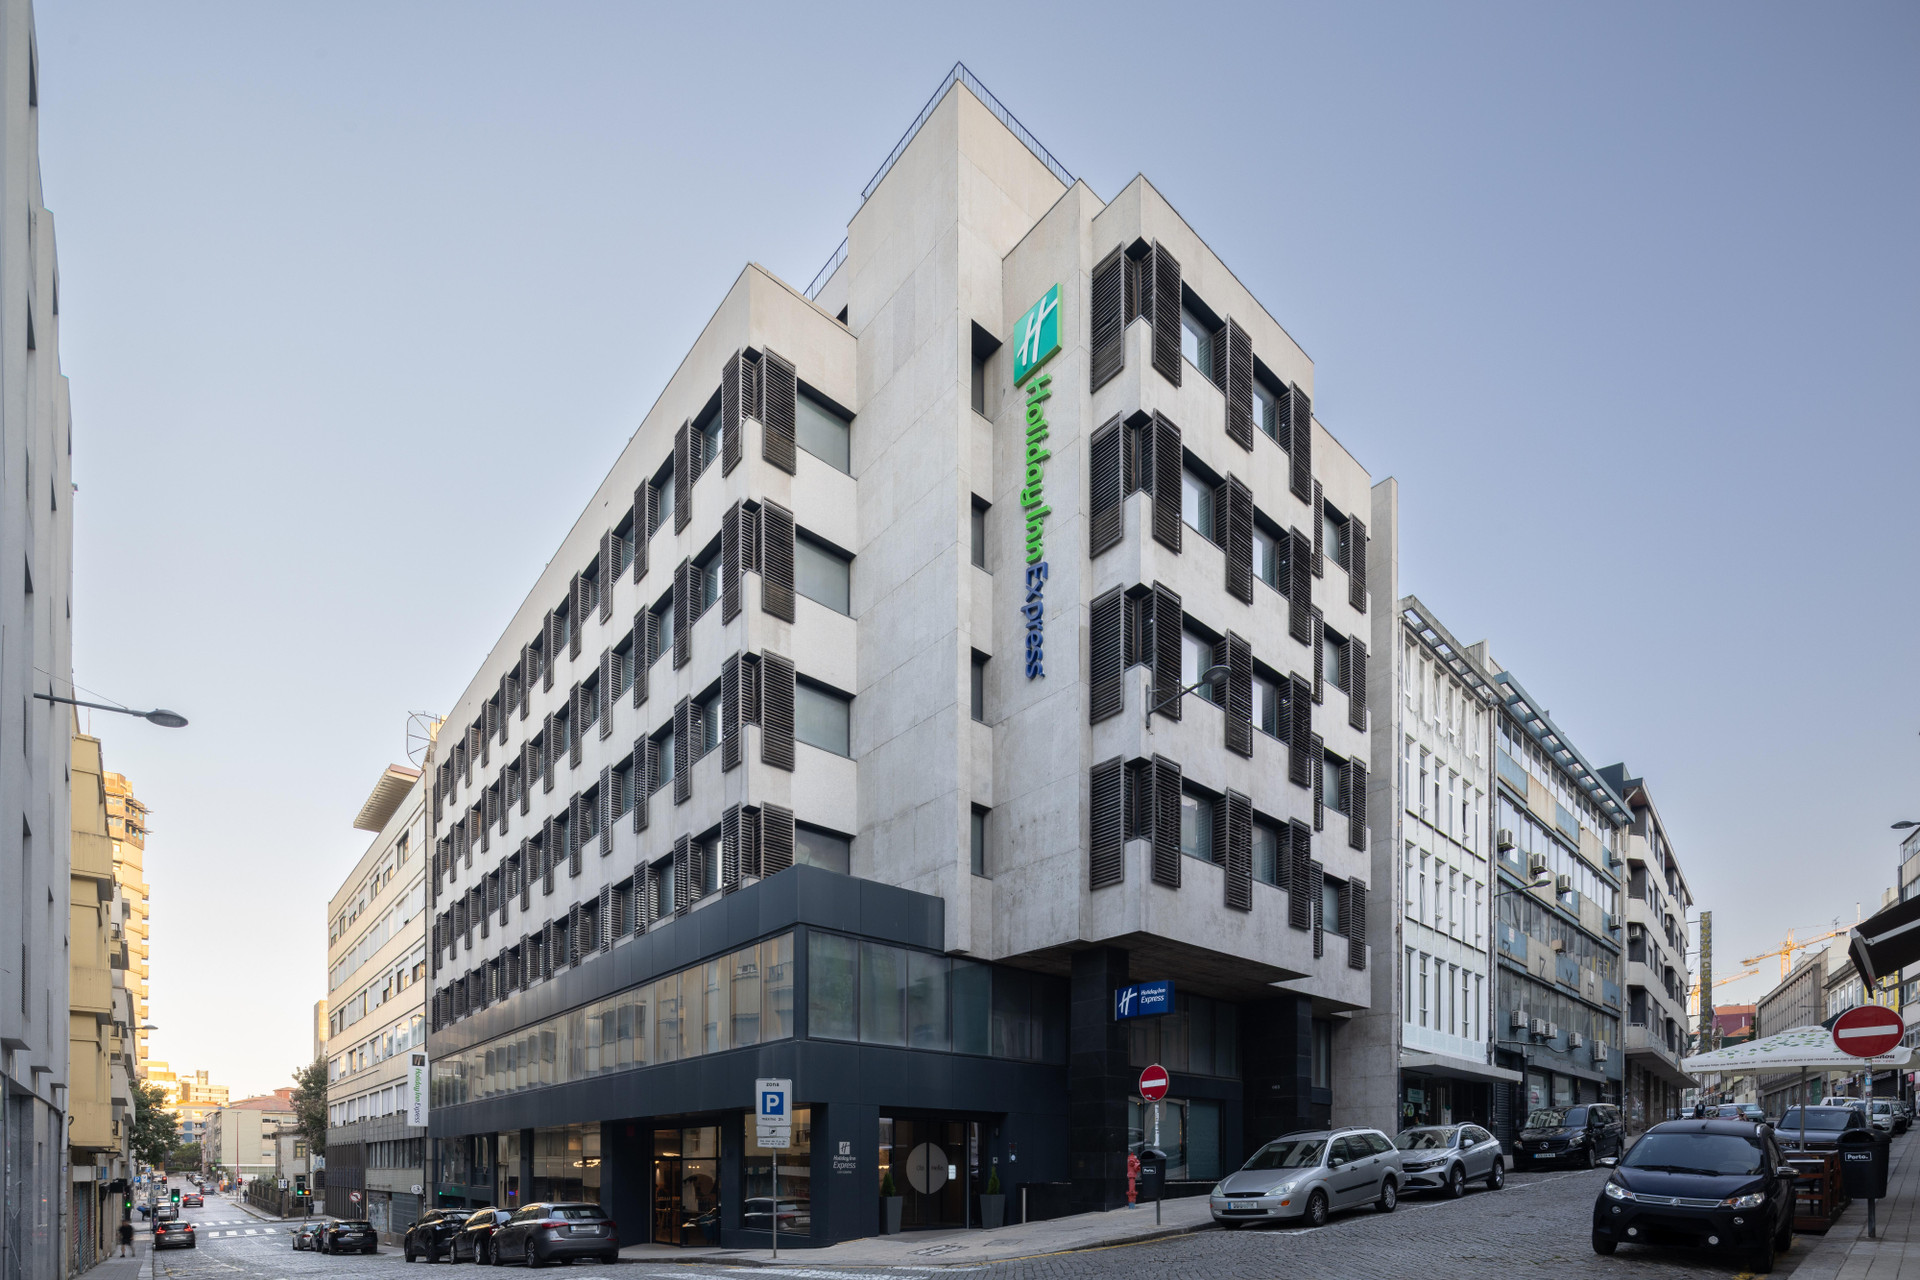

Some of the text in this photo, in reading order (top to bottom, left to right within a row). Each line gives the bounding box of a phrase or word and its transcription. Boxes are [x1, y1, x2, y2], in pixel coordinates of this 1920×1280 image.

[1020, 373, 1052, 565] Holiday Inn
[1020, 561, 1049, 681] Express
[1140, 988, 1158, 996] Holiday
[1140, 995, 1165, 1004] Express
[414, 1068, 422, 1091] Holiday
[414, 1102, 422, 1124] Express
[766, 1094, 780, 1113] P
[833, 1161, 856, 1170] Express
